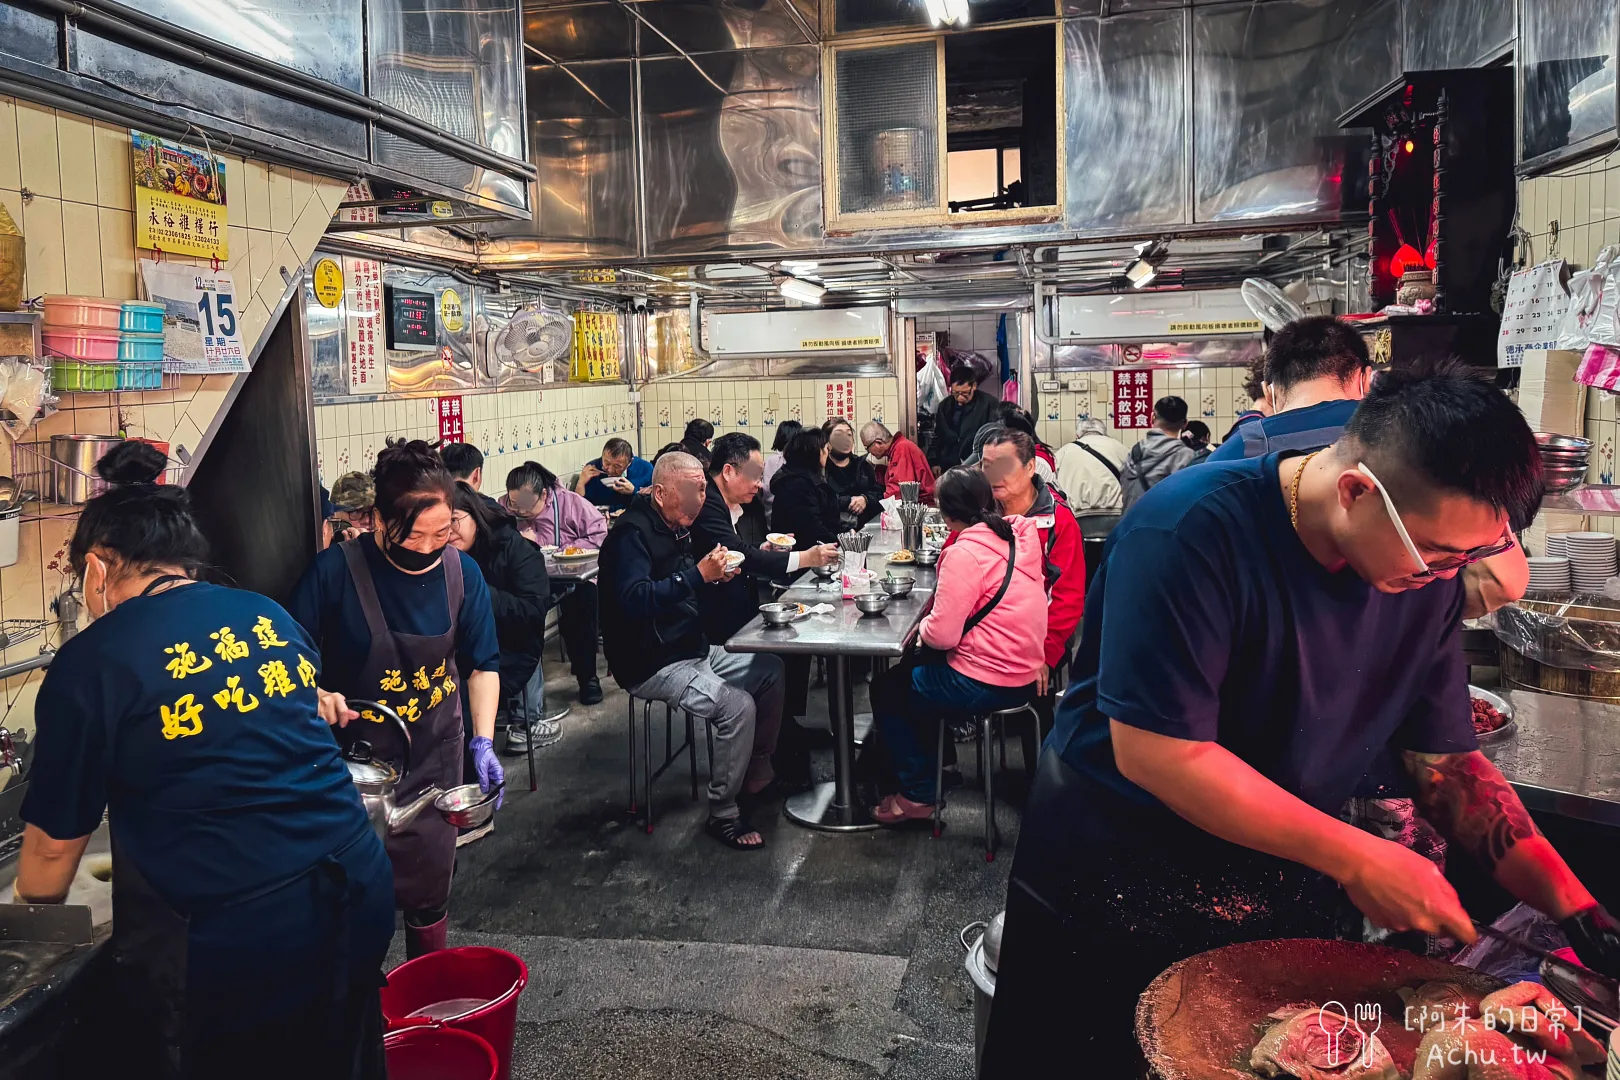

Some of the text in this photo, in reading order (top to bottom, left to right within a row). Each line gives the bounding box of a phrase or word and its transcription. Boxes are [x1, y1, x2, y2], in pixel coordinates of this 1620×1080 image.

[197, 292, 236, 337] 15
[204, 336, 239, 347] 星期一
[1117, 372, 1132, 427] 禁止飲酒
[1134, 372, 1149, 427] 禁止外食
[160, 653, 317, 740] 好吃雞肉
